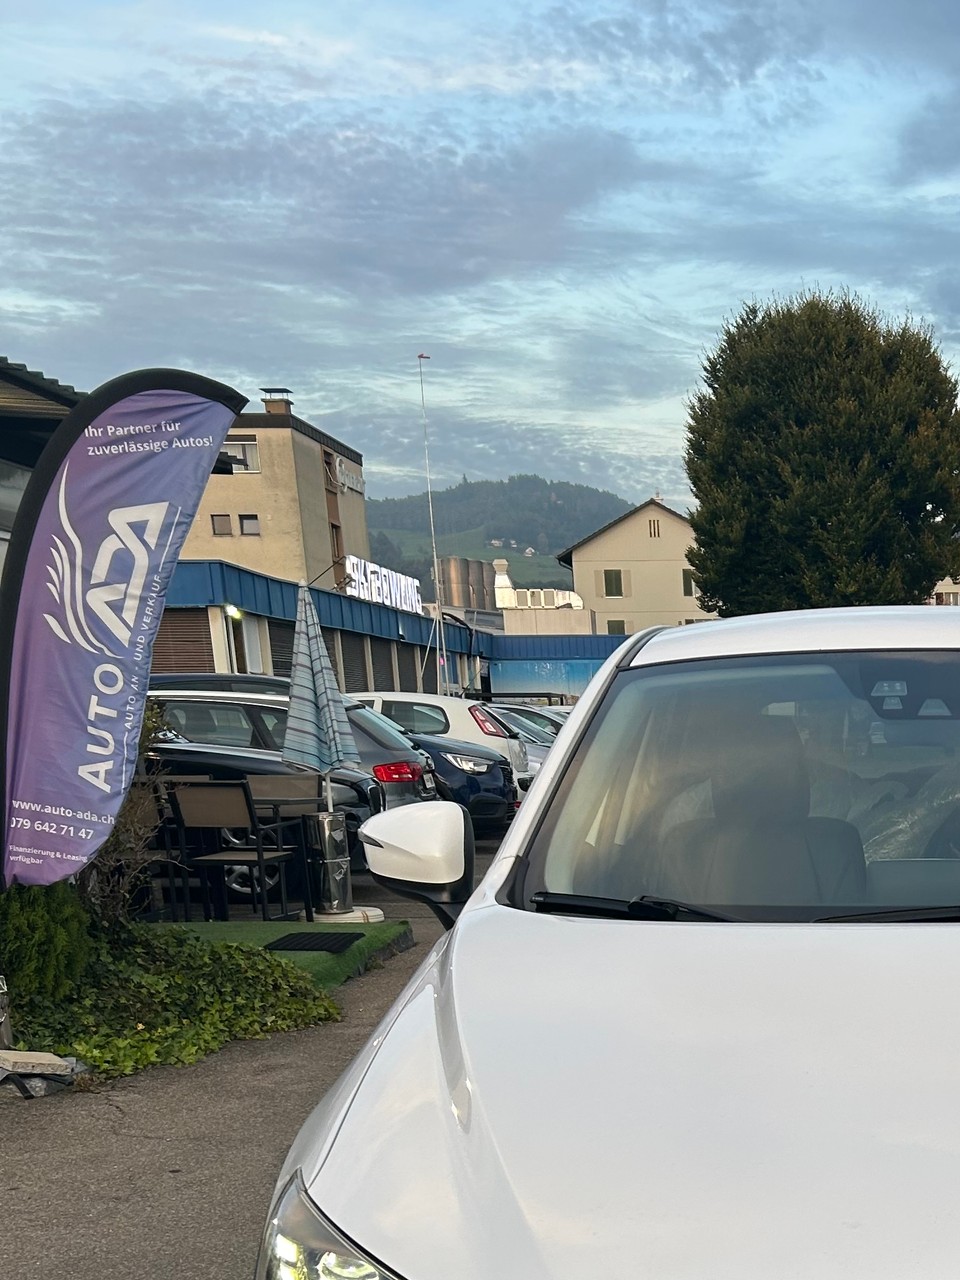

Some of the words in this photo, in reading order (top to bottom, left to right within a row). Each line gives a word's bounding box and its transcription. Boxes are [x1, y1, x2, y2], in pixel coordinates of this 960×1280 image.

[85, 425, 104, 437] Ihr
[107, 423, 157, 436] Partner
[161, 421, 181, 432] für
[87, 440, 169, 456] zuverlässige
[172, 435, 214, 448] Autos!
[140, 574, 162, 632] VERKAUF
[133, 635, 146, 661] UND
[131, 675, 139, 691] AN
[124, 695, 136, 729] AUTO
[78, 663, 123, 793] AUTO
[12, 800, 115, 824] www.auto-ada.ch
[34, 820, 57, 834] 642
[60, 825, 74, 837] 71
[78, 828, 94, 840] 47
